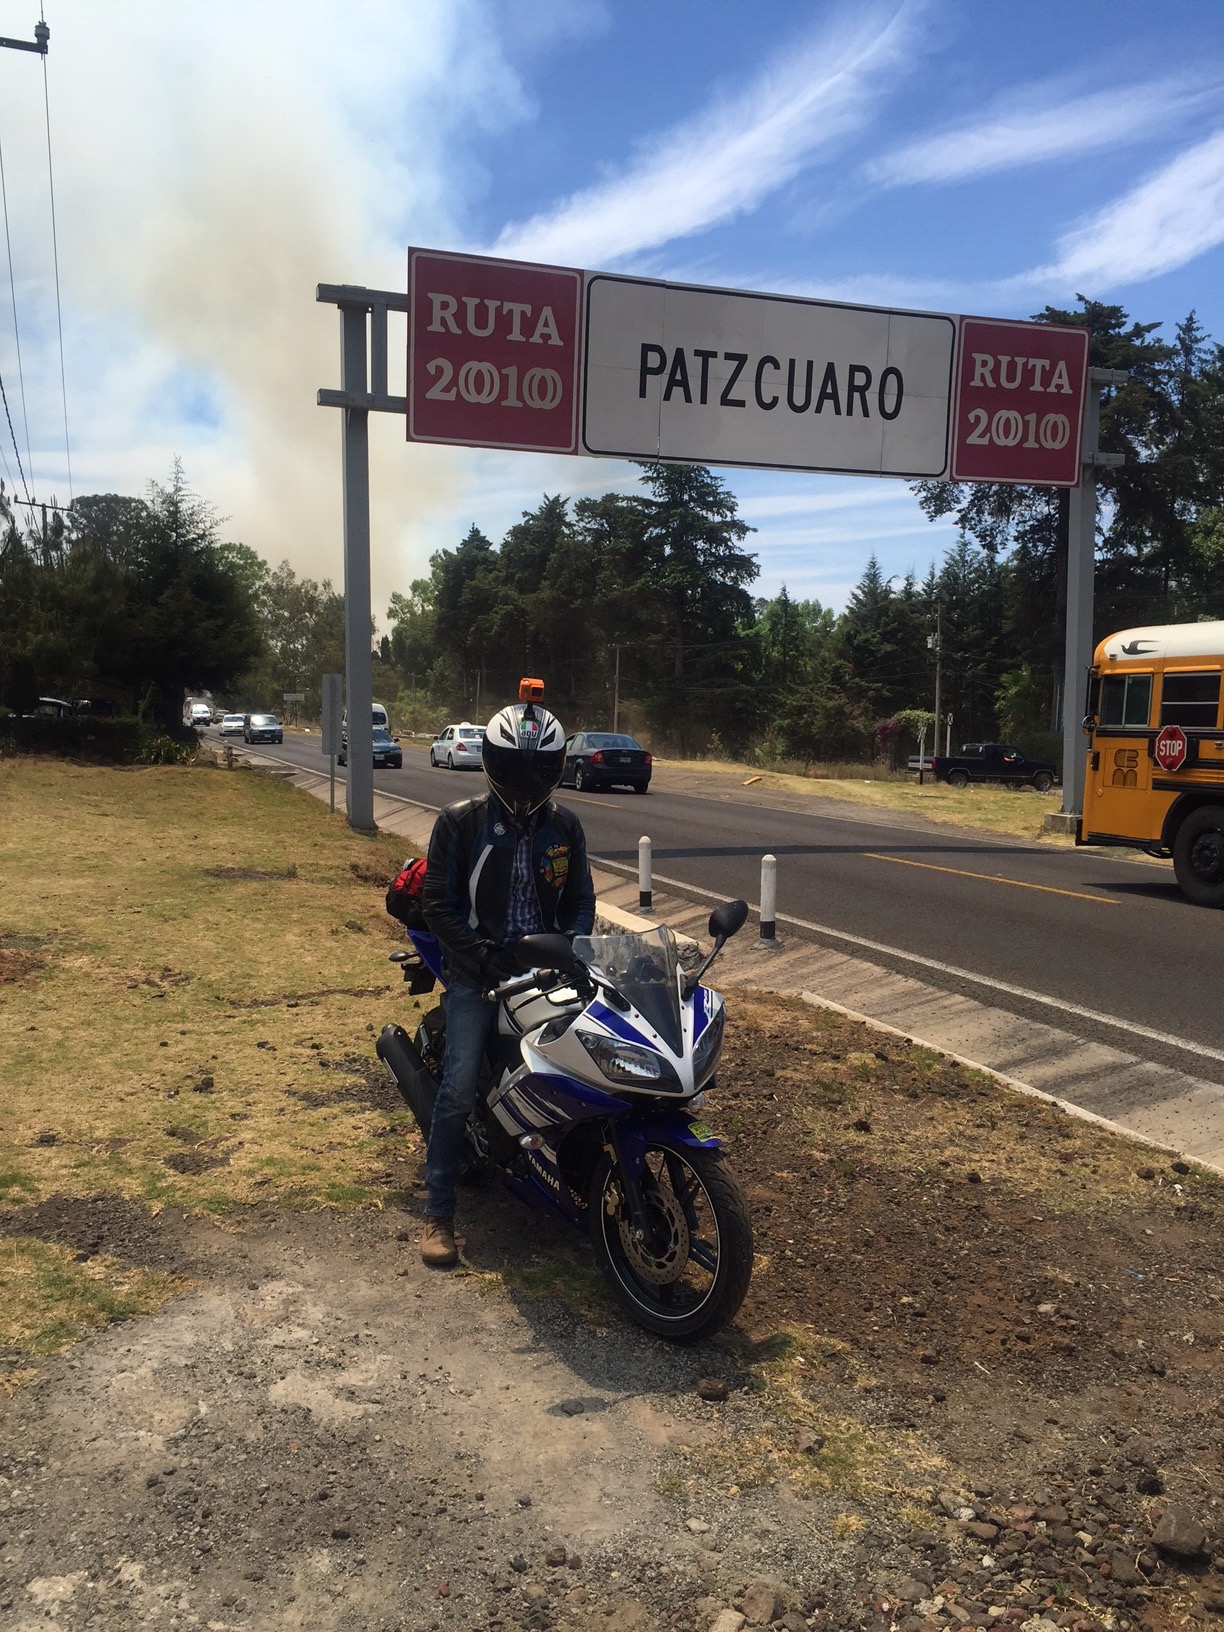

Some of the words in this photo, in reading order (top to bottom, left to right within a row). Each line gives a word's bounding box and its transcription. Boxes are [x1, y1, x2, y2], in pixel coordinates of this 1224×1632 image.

[427, 292, 564, 347] RUTA
[425, 357, 563, 412] 2010
[639, 343, 904, 421] PATZCUARO
[970, 353, 1073, 396] RUTA
[967, 408, 1071, 450] 2010
[1160, 740, 1183, 756] STOP
[527, 1150, 560, 1192] YAMAHA
